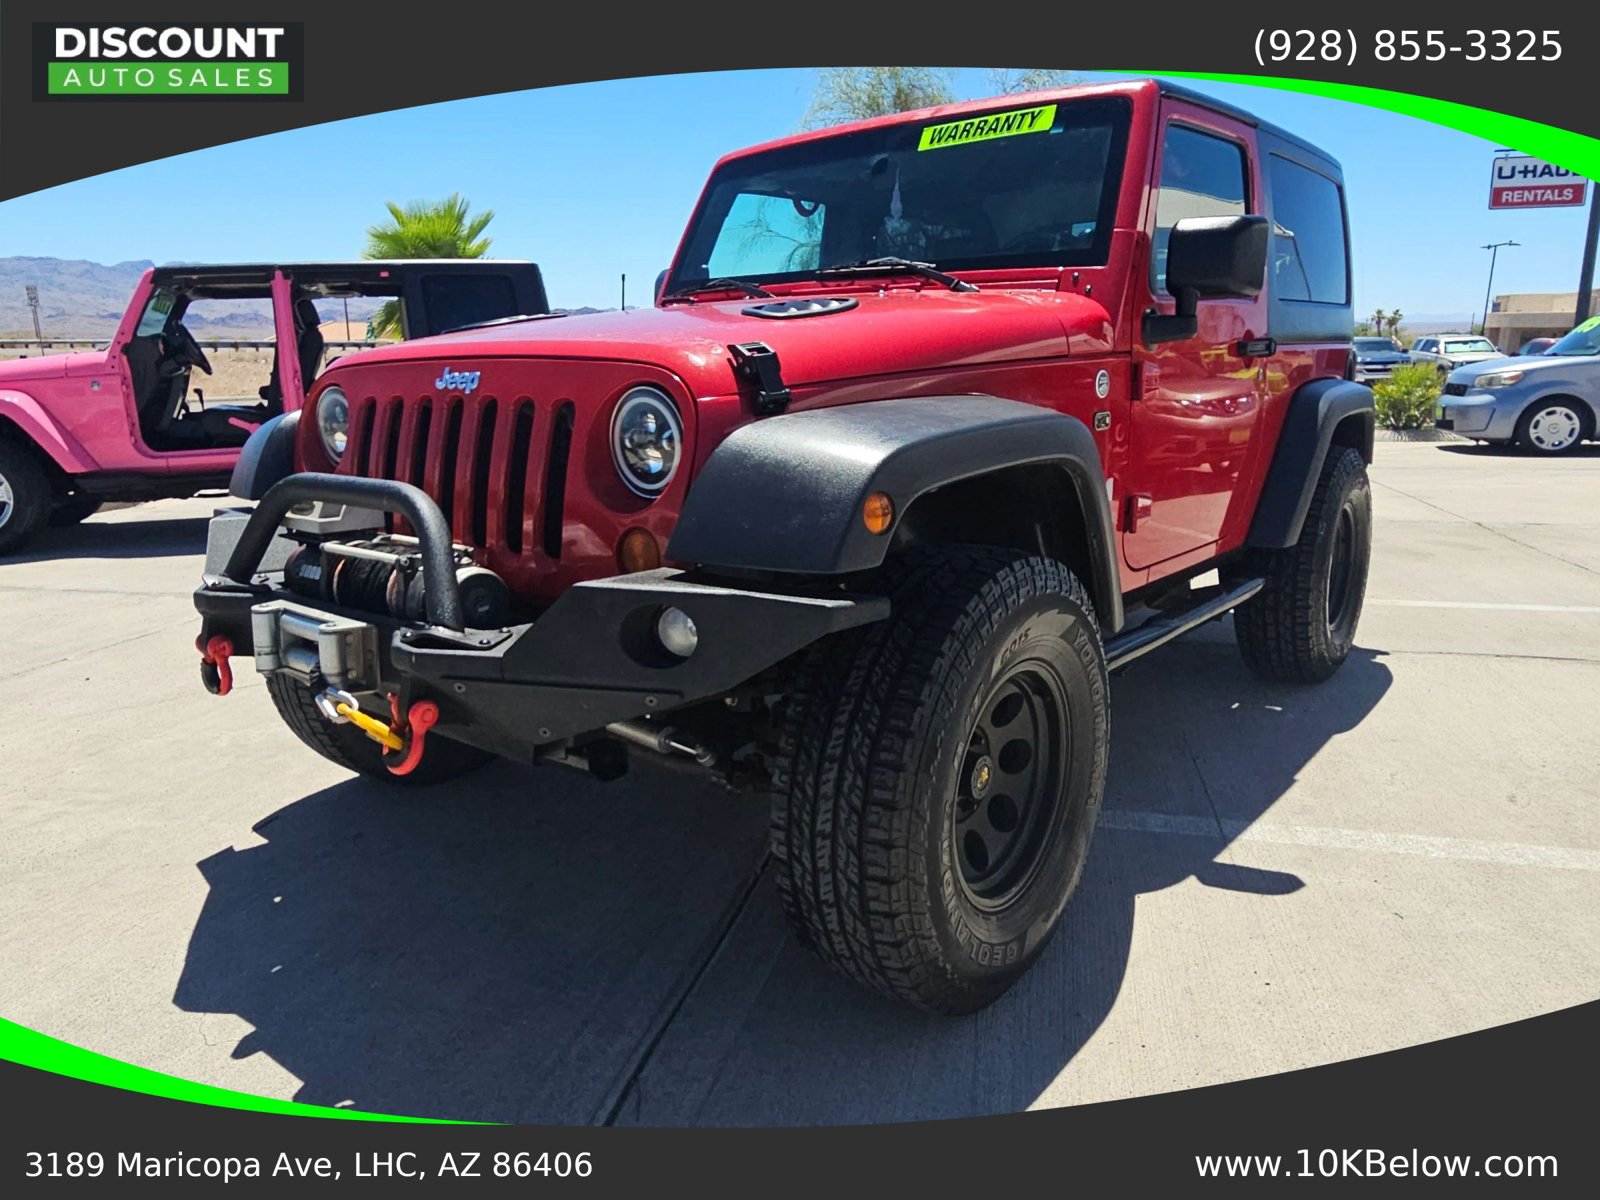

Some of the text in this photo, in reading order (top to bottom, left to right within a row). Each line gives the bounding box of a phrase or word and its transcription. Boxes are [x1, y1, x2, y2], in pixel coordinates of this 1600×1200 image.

[928, 109, 1043, 145] WARRANTY
[1497, 163, 1581, 180] U-HAU
[1501, 188, 1574, 203] RENTALS
[435, 366, 481, 394] Jeep
